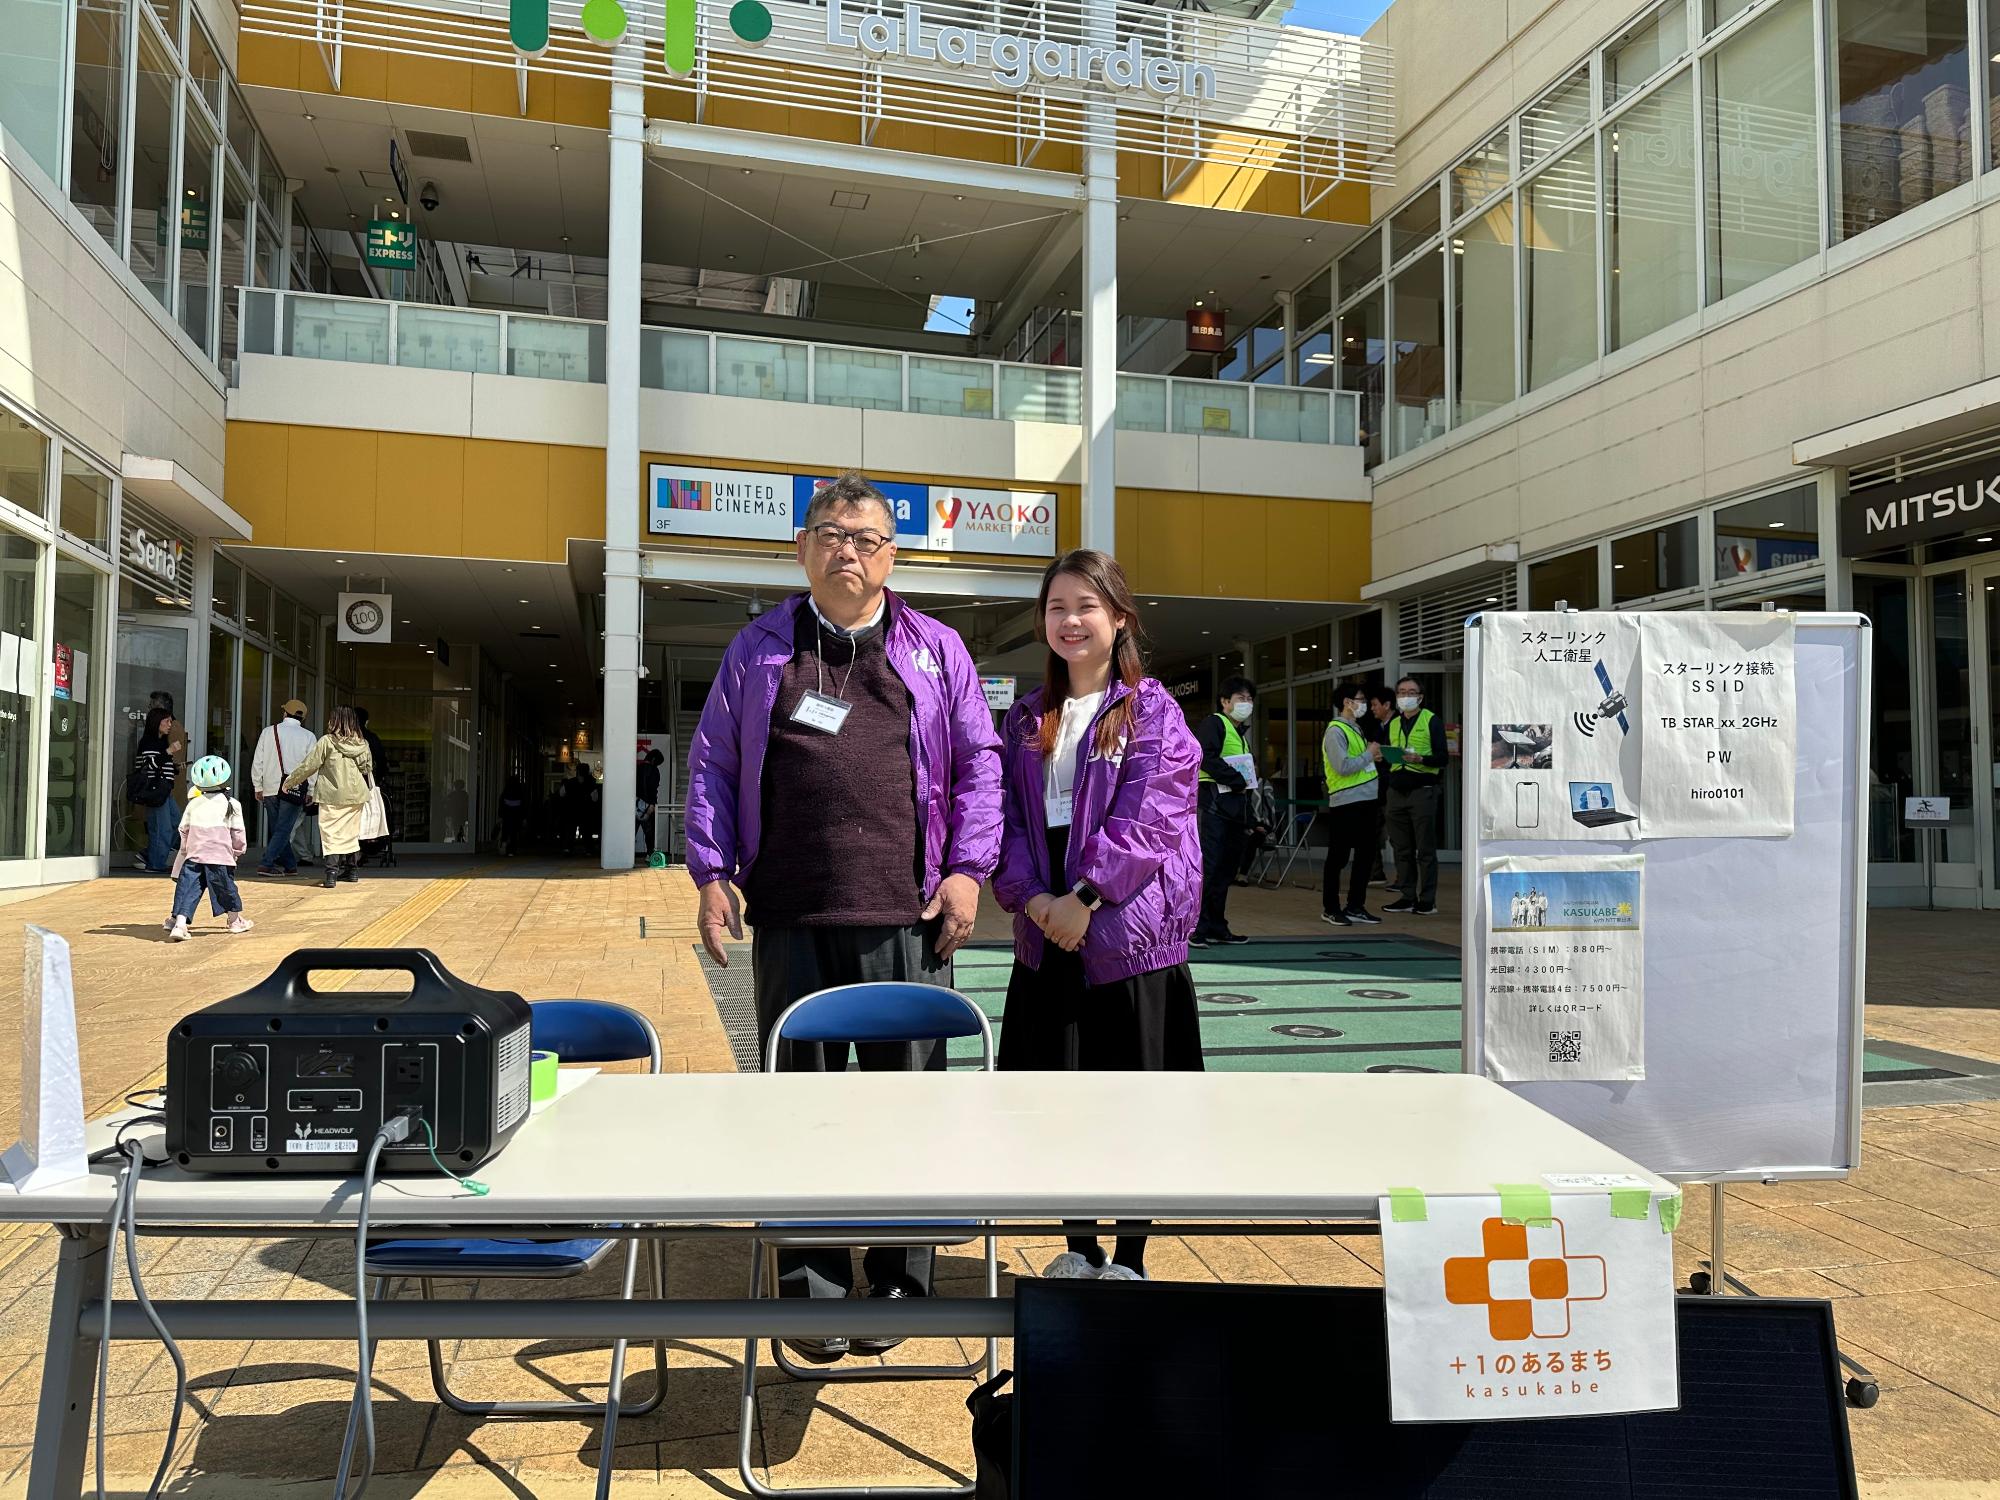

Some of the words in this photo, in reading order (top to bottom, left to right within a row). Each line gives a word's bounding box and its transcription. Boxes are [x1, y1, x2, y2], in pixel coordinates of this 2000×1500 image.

[826, 0, 977, 66] LaLa
[989, 38, 1217, 101] garden
[369, 228, 414, 248] ニトリ
[369, 247, 414, 260] EXPRESS
[1191, 325, 1223, 337] 無印良品
[715, 482, 773, 499] UNITED
[715, 498, 787, 516] CINEMAS
[966, 501, 1050, 524] YAOKO
[656, 519, 671, 529] 3F
[965, 521, 1051, 536] MARKETPLACE
[935, 538, 948, 547] 1F
[135, 528, 176, 581] Seria
[353, 610, 376, 625] 100
[1521, 631, 1607, 644] スターリンク
[1534, 648, 1593, 663] 人工衛星
[1663, 661, 1775, 676] スターリンク接続
[1692, 680, 1744, 693] SSID
[1661, 717, 1778, 730] TB_STAR_xx_2GHz
[1707, 751, 1732, 764] PW
[1691, 788, 1744, 799] hiro0101
[1528, 1004, 1603, 1013] 詳しくはQRコード
[1449, 1349, 1613, 1375] +1のあるまち
[1466, 1380, 1599, 1398] kasukabe
